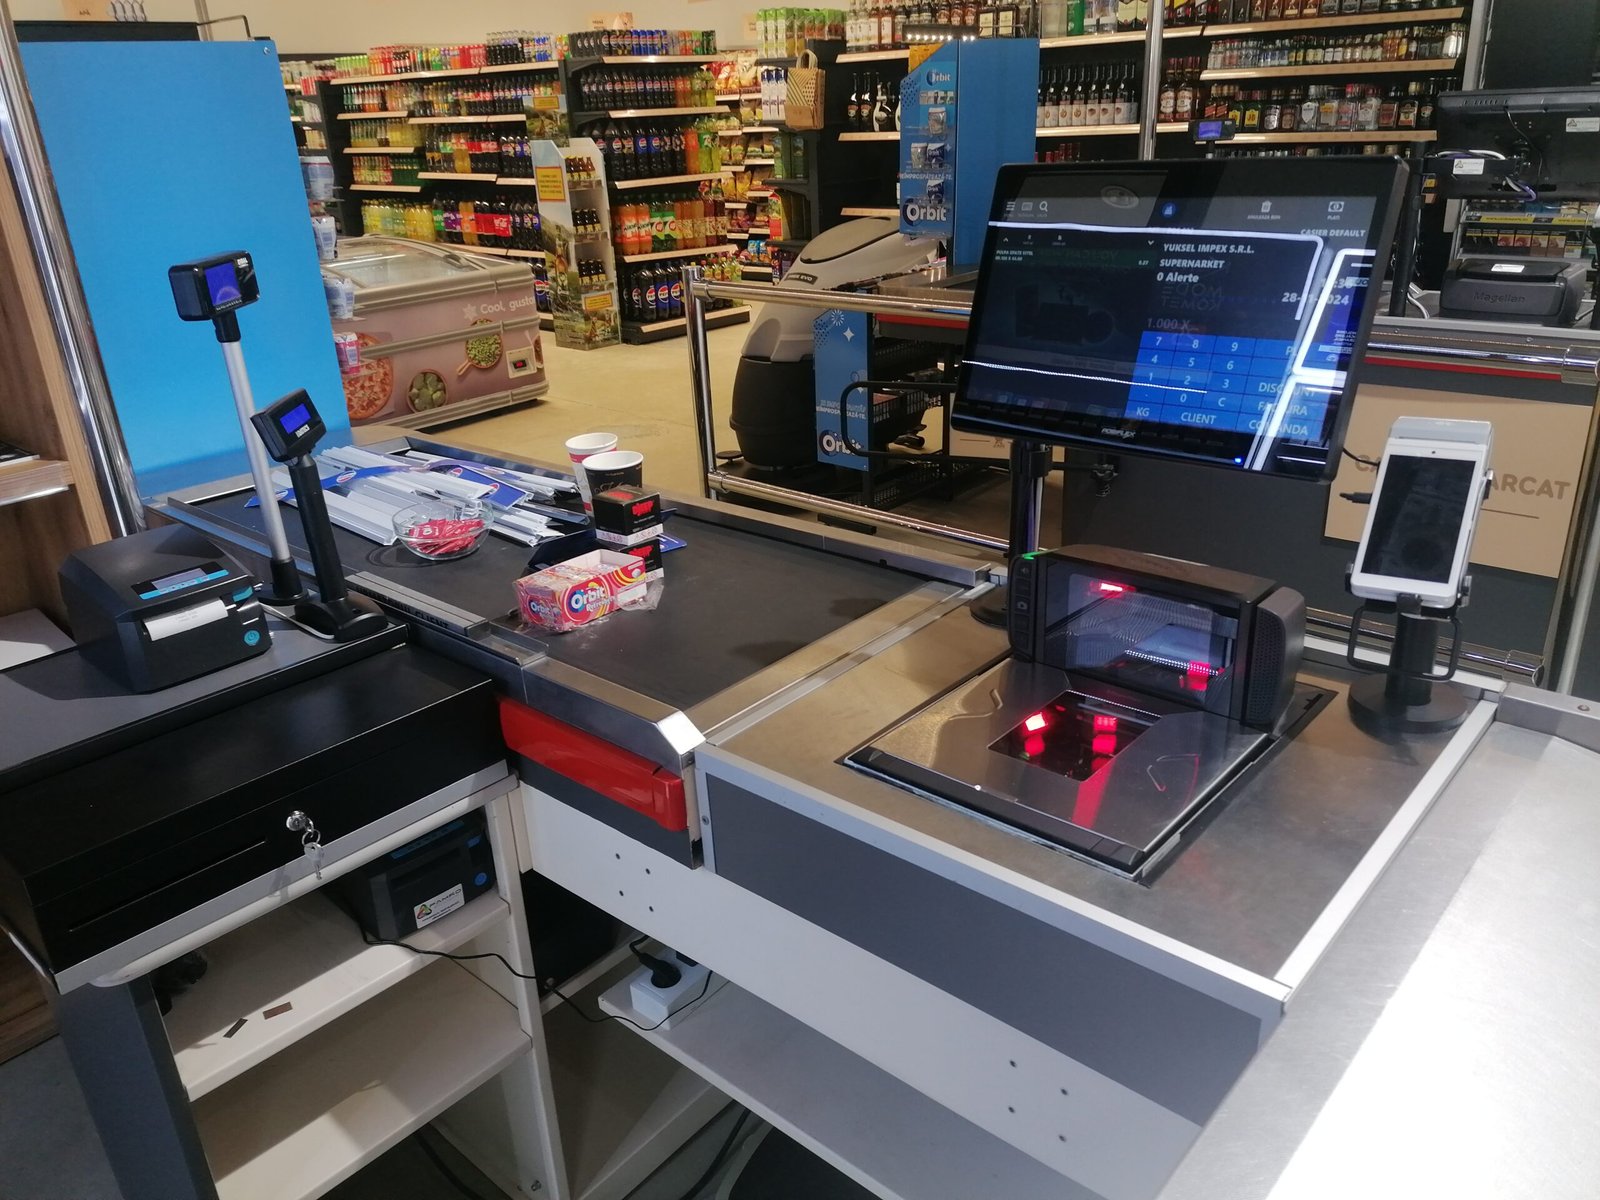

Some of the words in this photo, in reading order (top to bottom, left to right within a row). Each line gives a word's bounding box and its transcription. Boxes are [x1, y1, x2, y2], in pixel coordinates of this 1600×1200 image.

[906, 204, 947, 222] Orbit
[1301, 229, 1328, 237] CASIER
[1329, 229, 1366, 238] DEFAULT
[1163, 243, 1196, 253] YUKSEL
[1198, 244, 1228, 253] IMPEX
[1229, 245, 1255, 254] S.R.L.
[1165, 271, 1199, 284] Alerte
[1473, 291, 1526, 304] Magellan
[1147, 318, 1177, 330] 1.000
[1155, 336, 1163, 346] 7
[1192, 339, 1200, 349] 8
[1231, 342, 1238, 352] 9
[1151, 354, 1159, 364] 4
[1188, 357, 1195, 367] 5
[1226, 360, 1234, 370] 6
[1183, 375, 1191, 385] 2
[1222, 378, 1230, 389] 3
[1179, 393, 1187, 403] 0
[1218, 397, 1226, 407] C
[1136, 406, 1150, 417] KG
[1181, 411, 1216, 425] CLIENT
[571, 586, 606, 609] Orbit
